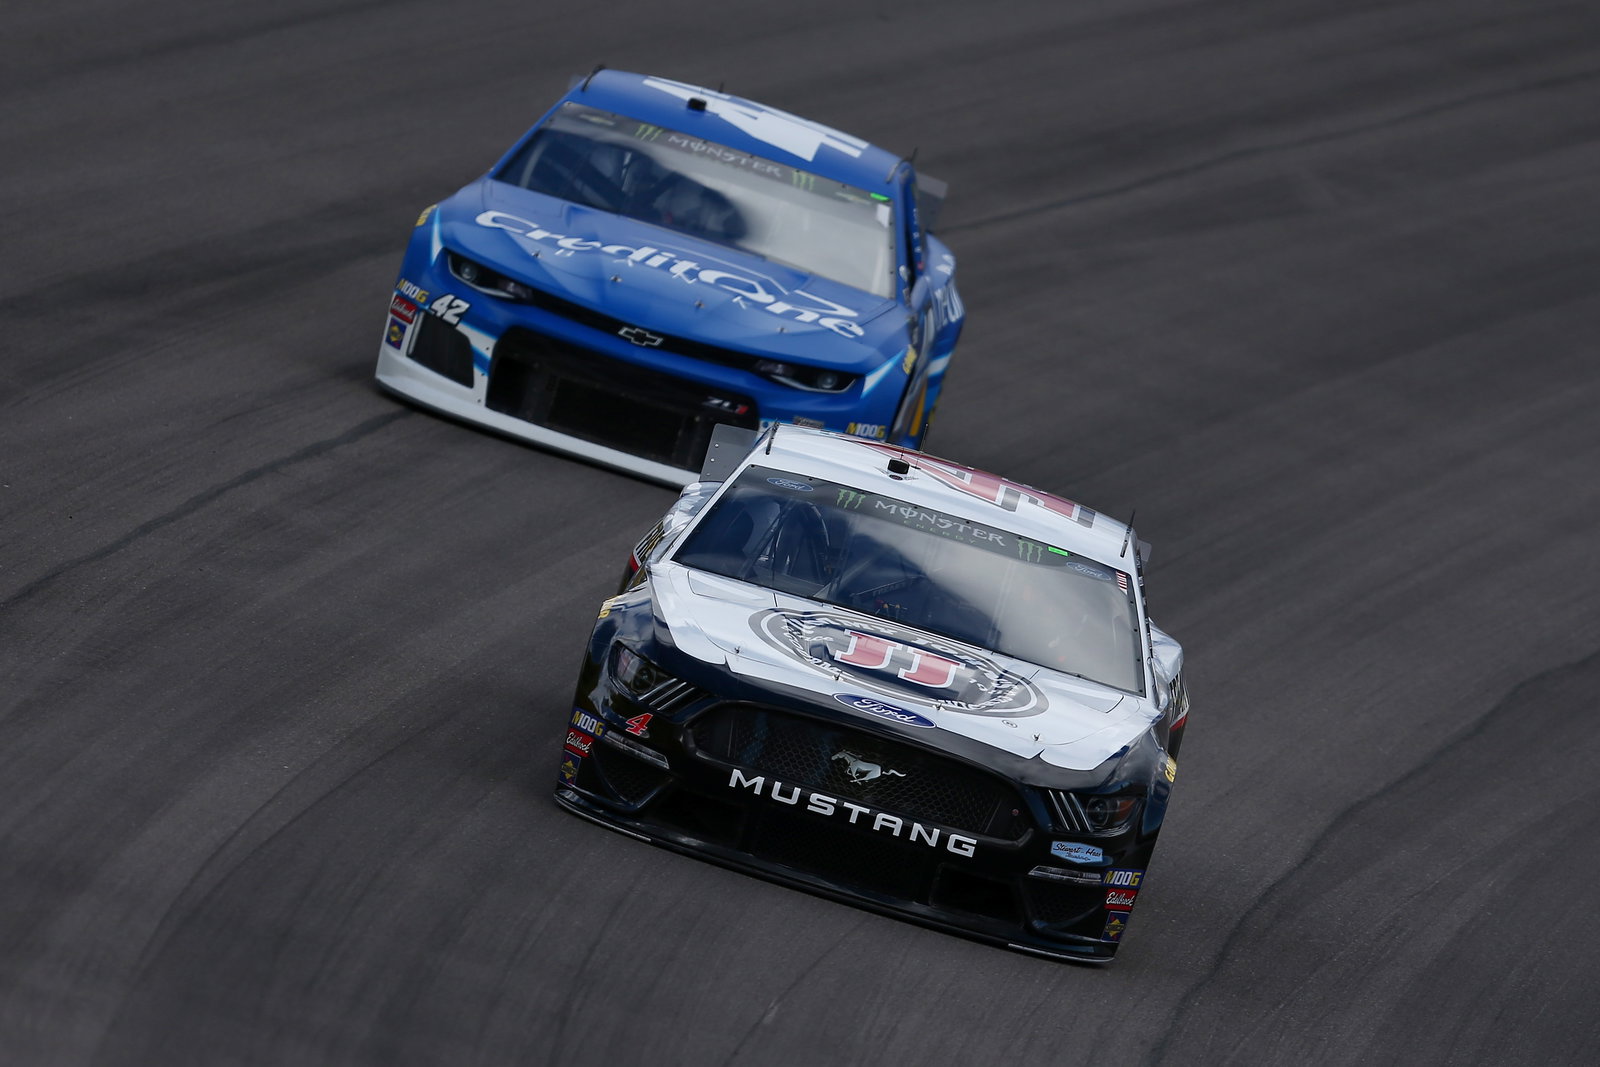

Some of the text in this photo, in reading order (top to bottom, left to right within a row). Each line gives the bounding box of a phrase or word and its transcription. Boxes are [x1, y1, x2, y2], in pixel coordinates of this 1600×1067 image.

[396, 279, 429, 303] MOOG
[430, 294, 471, 326] 42
[847, 422, 885, 438] MOOG
[903, 520, 977, 545] ENERGY
[833, 628, 966, 689] JJ
[853, 697, 918, 724] Ford
[571, 711, 605, 736] MOOG
[625, 713, 654, 737] 4
[728, 768, 978, 858] MUSTANG
[1104, 871, 1142, 886] MOOG
